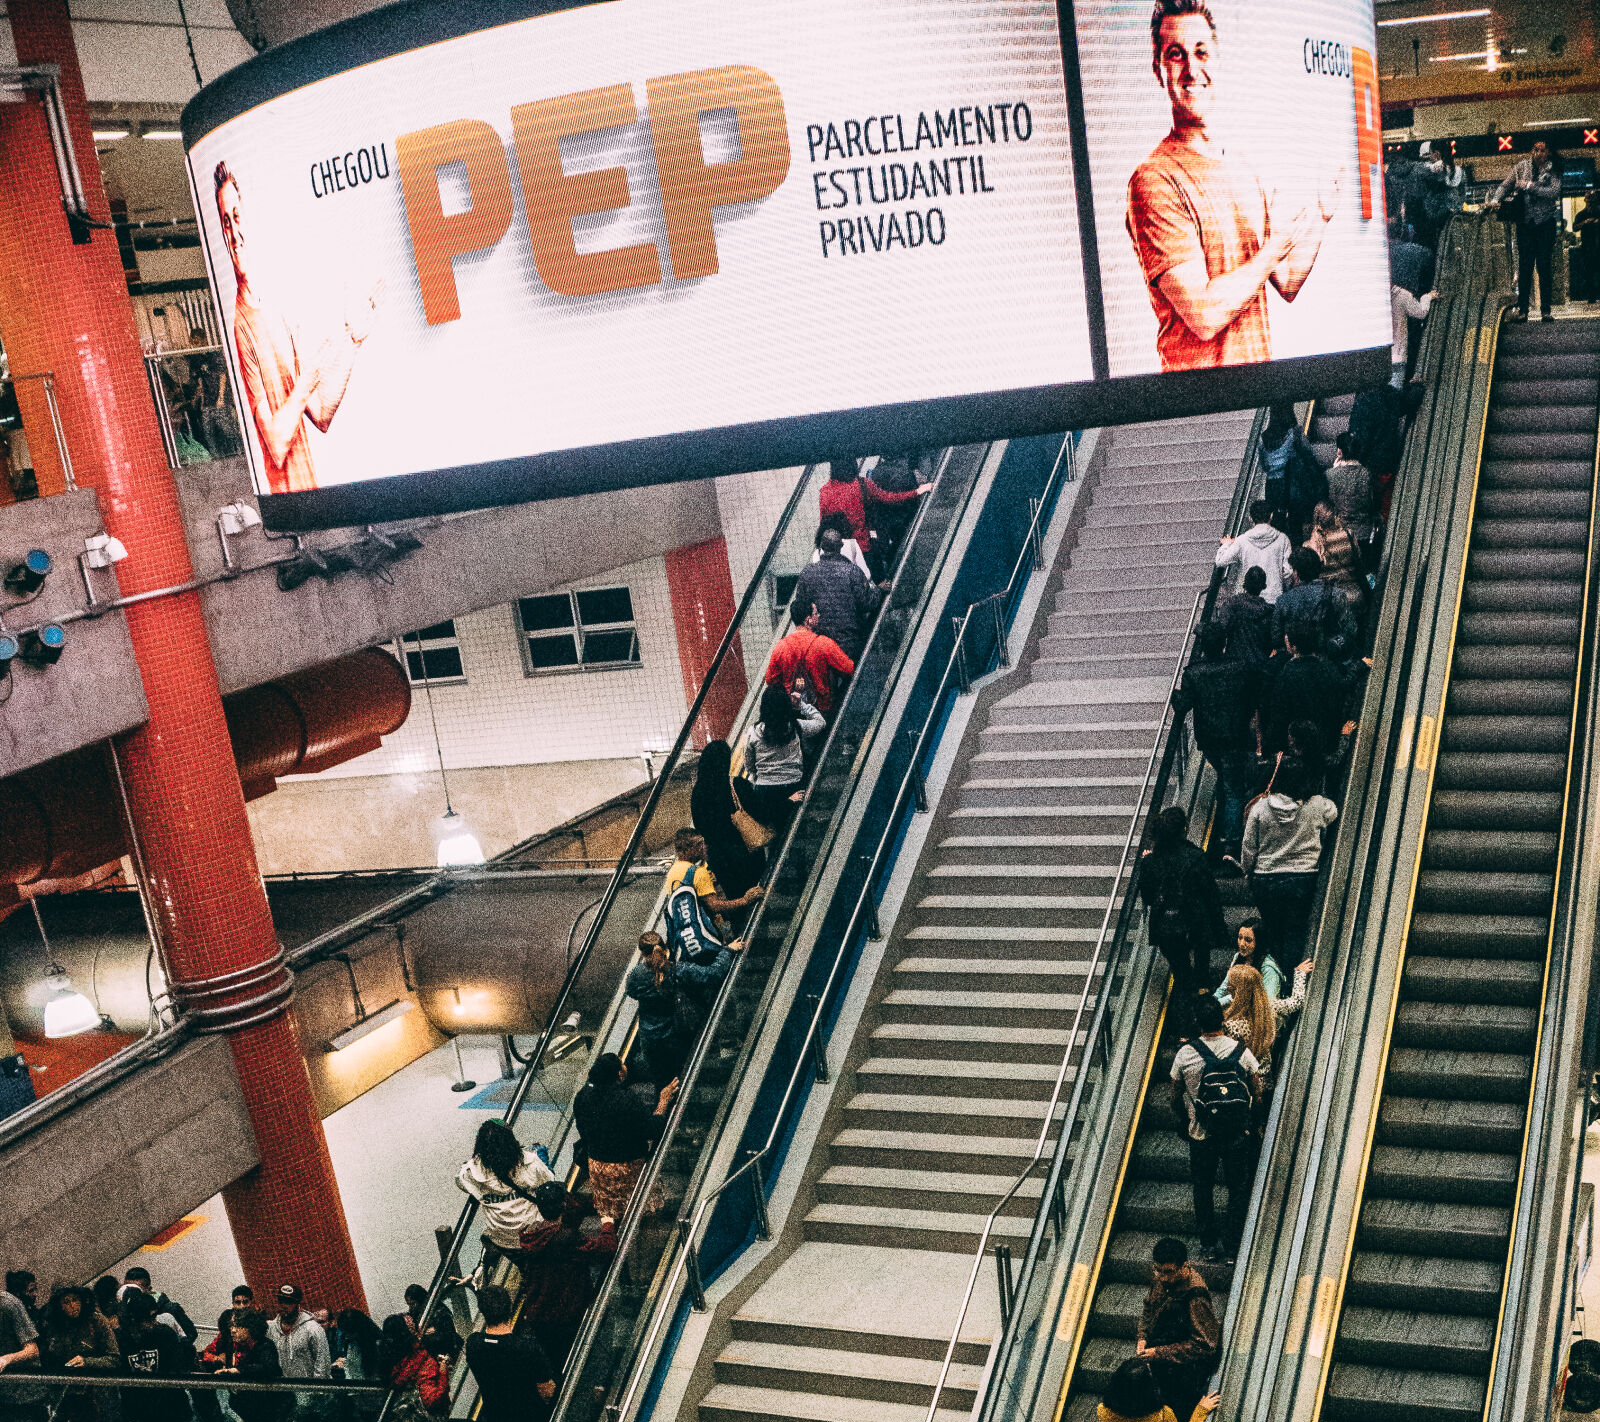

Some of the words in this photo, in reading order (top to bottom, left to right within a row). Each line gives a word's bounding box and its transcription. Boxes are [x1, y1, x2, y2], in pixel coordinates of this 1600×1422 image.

[1304, 37, 1350, 78] CHEGOU
[807, 101, 1032, 162] PARCELAMENTO
[311, 143, 389, 198] CHEGOU
[395, 64, 791, 327] PEP
[813, 154, 995, 210] ESTUDANTIL
[820, 207, 946, 258] PRIVADO
